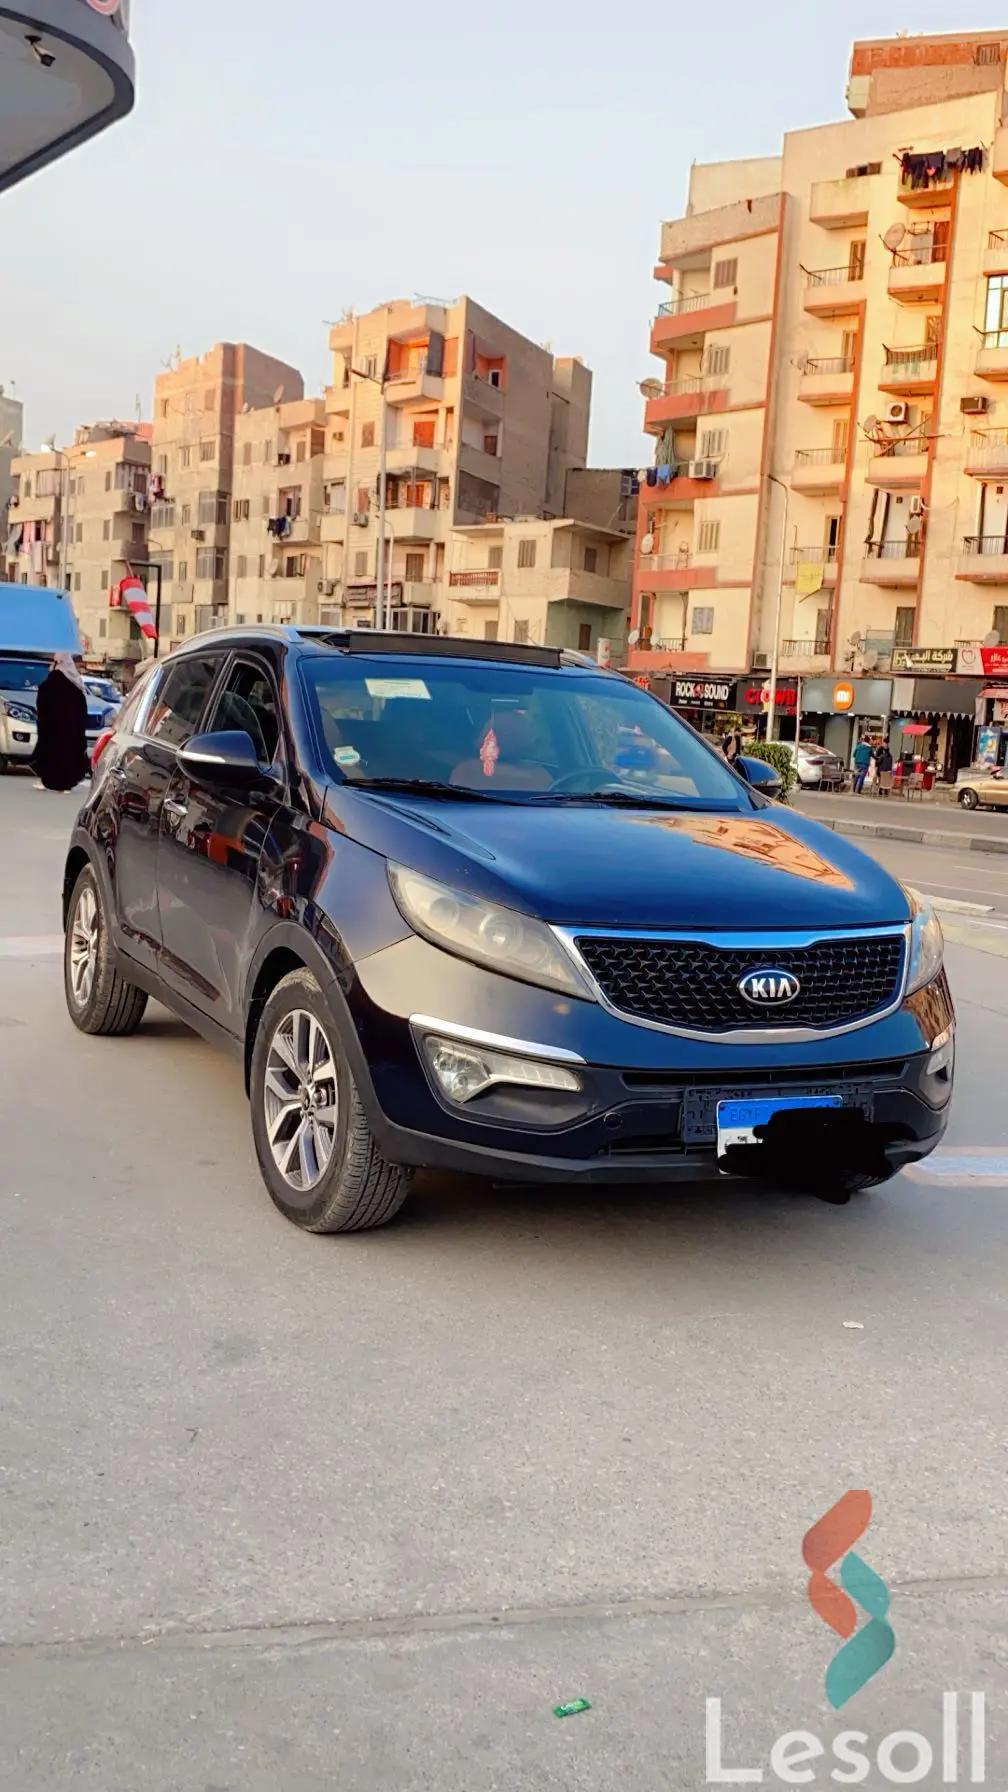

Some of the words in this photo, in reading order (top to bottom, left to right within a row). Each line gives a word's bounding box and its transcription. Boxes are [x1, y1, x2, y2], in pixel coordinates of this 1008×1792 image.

[675, 681, 695, 698] ROCK
[704, 683, 729, 700] SOUND
[752, 977, 792, 998] KIA
